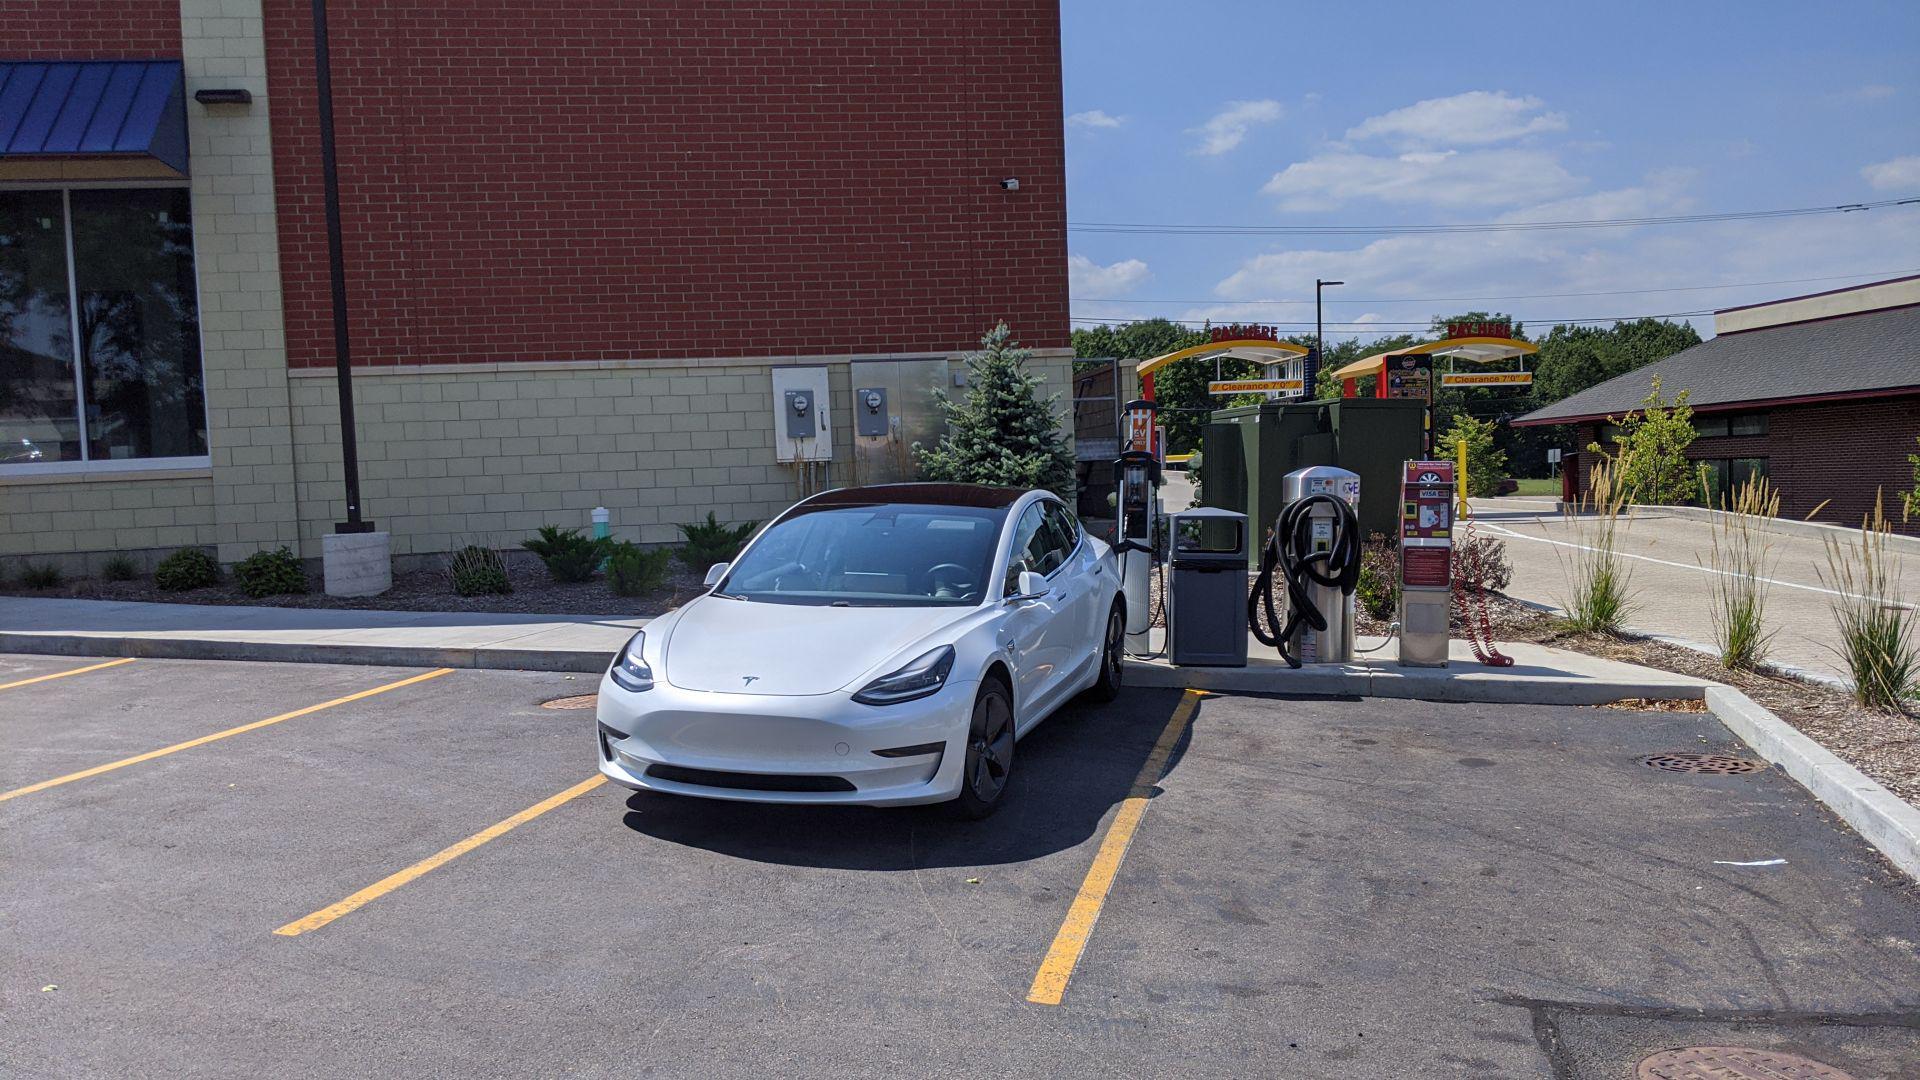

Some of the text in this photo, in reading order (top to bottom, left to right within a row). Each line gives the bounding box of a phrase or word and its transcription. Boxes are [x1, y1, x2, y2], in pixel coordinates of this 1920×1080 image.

[1212, 325, 1279, 342] PAY HERE
[1448, 322, 1511, 339] PAY HERE
[1454, 375, 1500, 384] Clearance
[1221, 382, 1269, 391] Clearance
